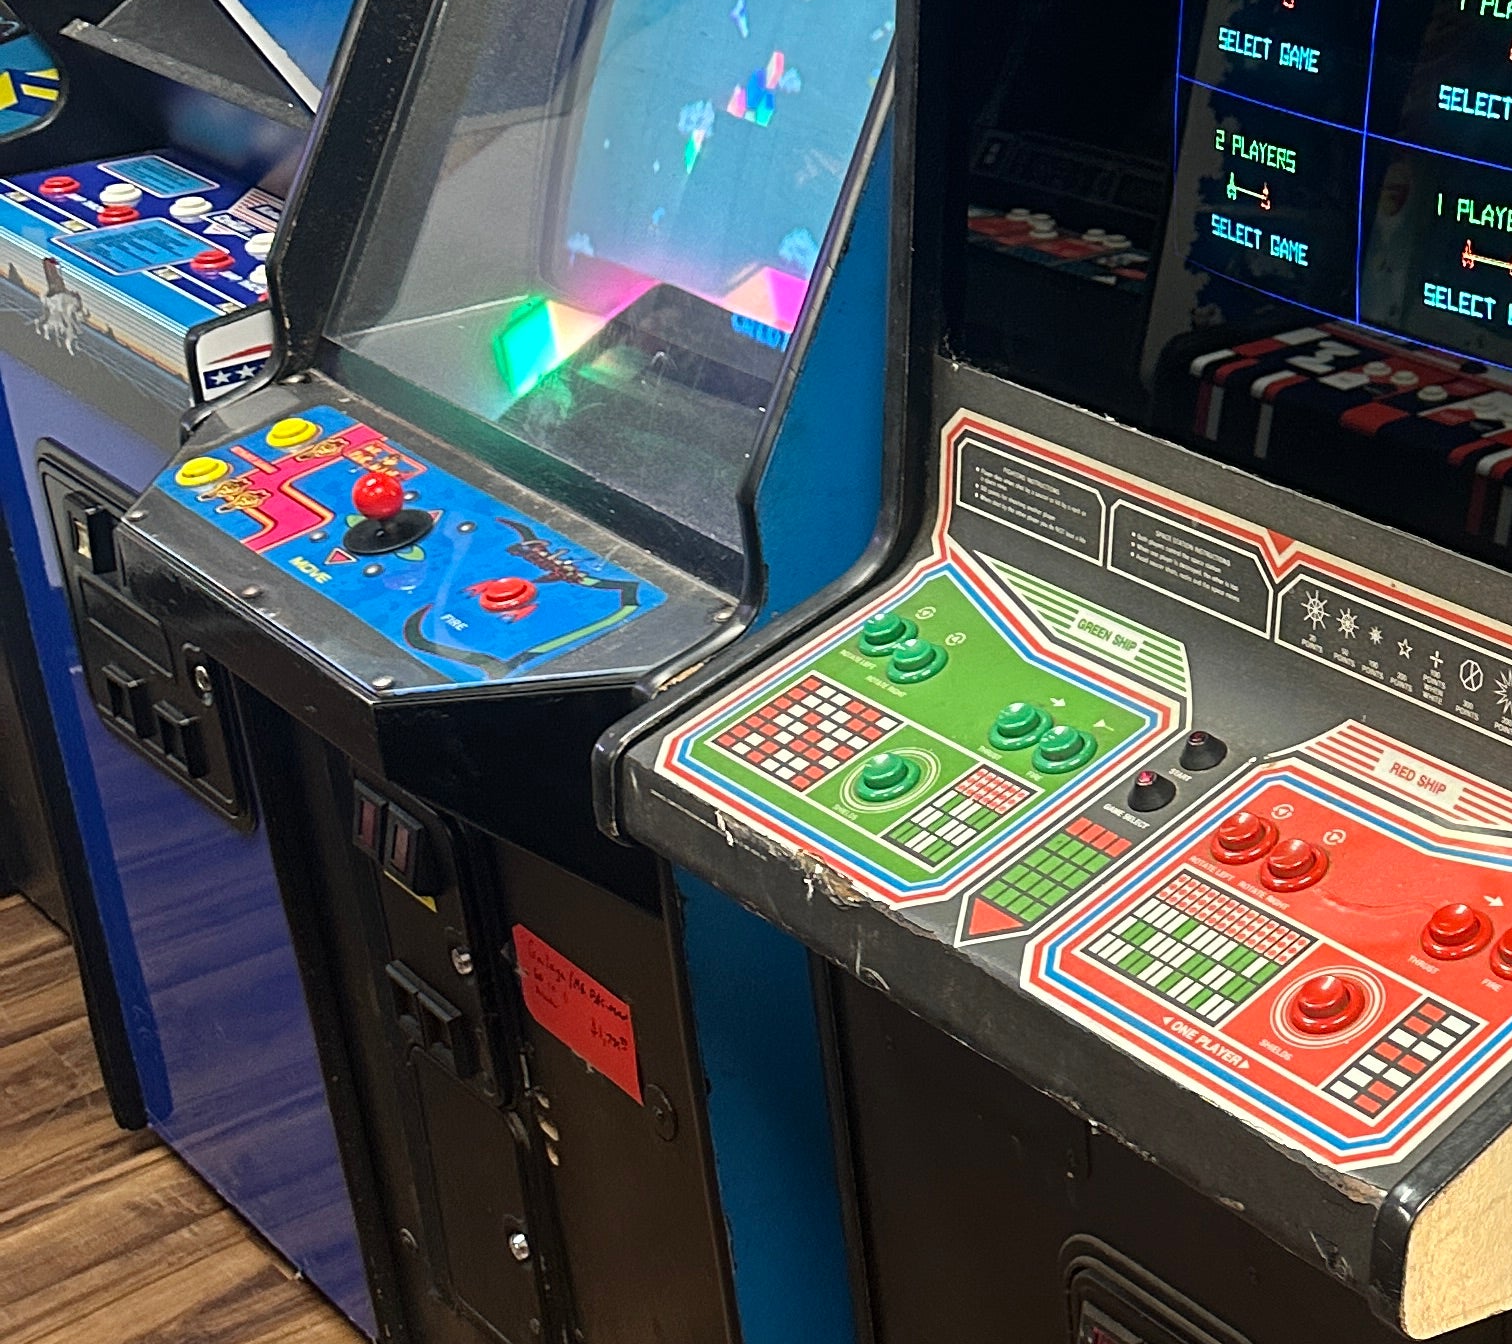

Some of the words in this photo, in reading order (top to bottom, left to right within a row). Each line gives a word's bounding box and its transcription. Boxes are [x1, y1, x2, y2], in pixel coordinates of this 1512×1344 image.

[1218, 26, 1273, 60] SELECT
[1279, 42, 1321, 74] GAME
[1215, 129, 1225, 151] 2
[1231, 134, 1297, 174] PLAYERS
[1211, 213, 1262, 251] SELECT
[1270, 234, 1310, 267] GAME
[1423, 282, 1497, 321] SELECT
[288, 556, 332, 584] MOVE
[440, 613, 469, 632] FIRE
[1077, 618, 1113, 642] GREEN
[1114, 634, 1138, 653] SHIP
[1301, 638, 1324, 654] POINTS
[1333, 652, 1356, 668] POINTS
[1361, 664, 1385, 680] POINTS
[1389, 676, 1413, 692] POINTS
[1422, 673, 1447, 690] POINTS
[1455, 704, 1480, 721] POINTS
[1168, 767, 1193, 783] START
[1389, 762, 1416, 784] RED
[1416, 774, 1447, 795] SHIP
[1103, 802, 1125, 819] GAME
[1122, 811, 1150, 830] SELECT
[1188, 855, 1215, 875] ROTATE
[1213, 866, 1236, 883] LEFT
[1237, 880, 1267, 901] ROTATE
[1264, 894, 1291, 911] RIGHT
[1408, 954, 1440, 975] THRUST
[1481, 977, 1505, 993] FIRE
[1171, 1020, 1200, 1042] ONE
[1198, 1032, 1243, 1065] PLAYER
[1258, 1038, 1294, 1061] SHIELDS
